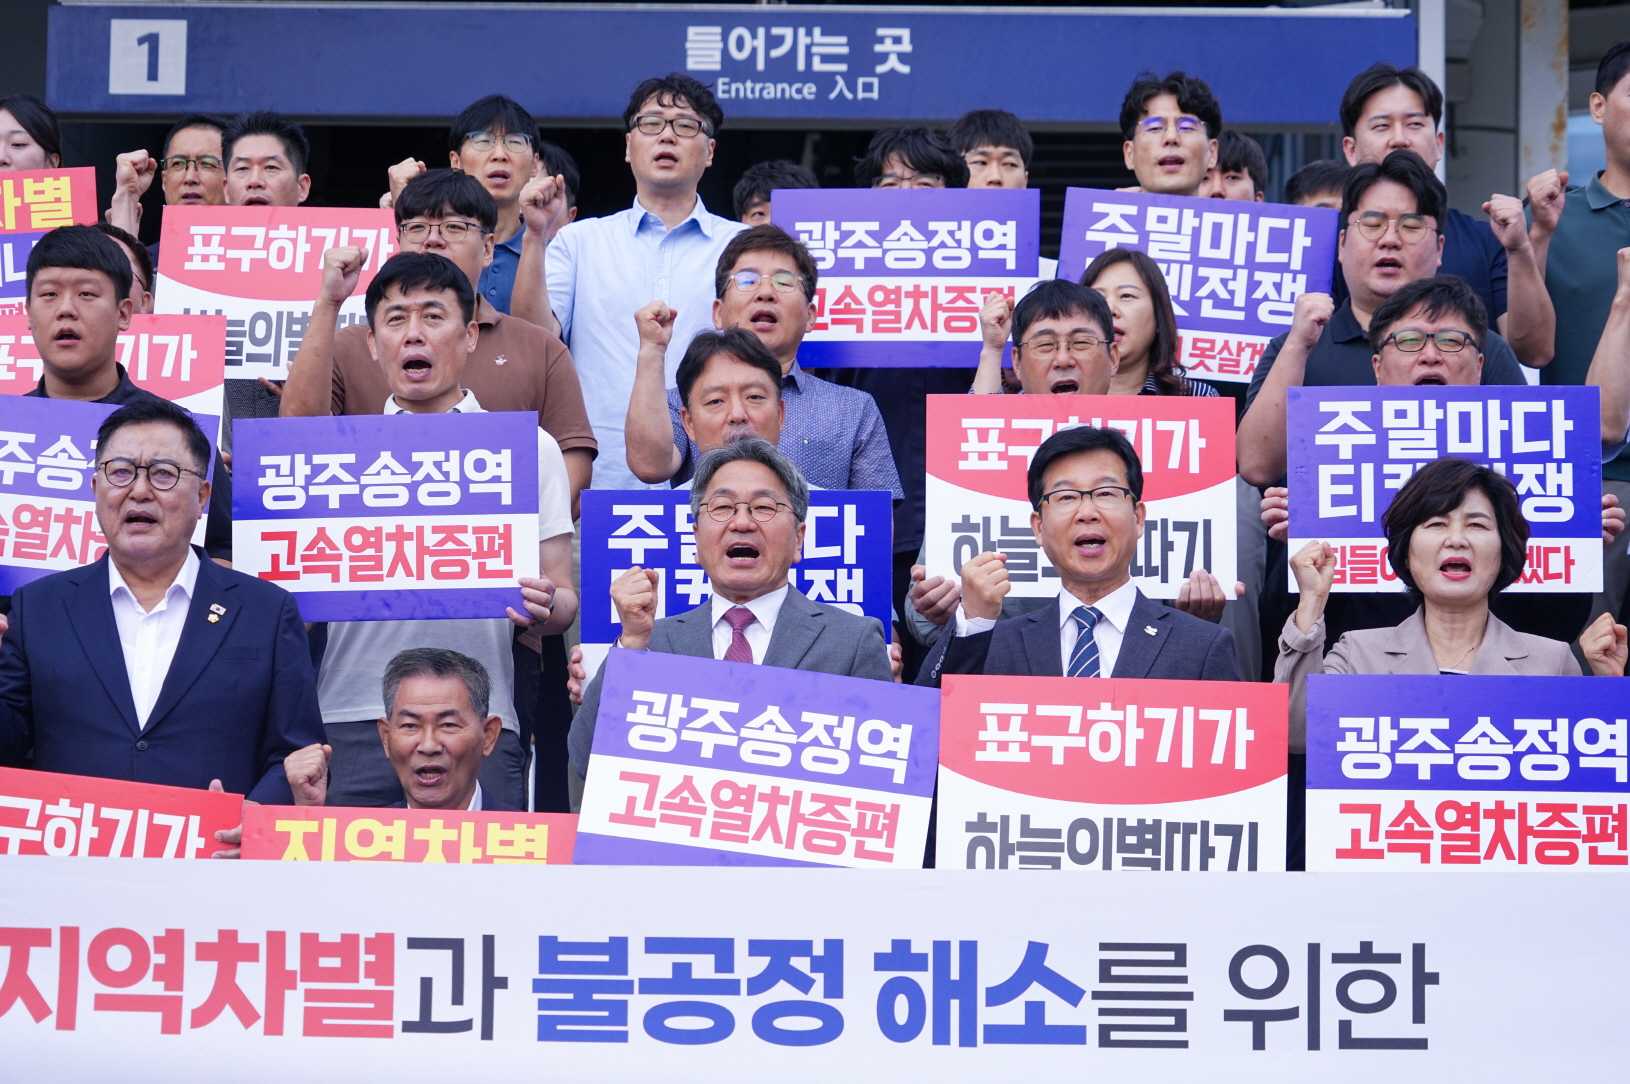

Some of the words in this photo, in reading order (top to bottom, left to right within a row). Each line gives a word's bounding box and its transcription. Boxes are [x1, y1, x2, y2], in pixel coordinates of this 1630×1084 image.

[136, 31, 160, 82] 1
[685, 25, 850, 72] 들어가는
[874, 27, 913, 75] 곳
[717, 76, 817, 100] Entrance
[794, 220, 1017, 270] 광주송정역
[1085, 202, 1312, 270] 주말마다
[1315, 399, 1574, 459] 주말마다
[257, 449, 512, 510] 광주송정역
[258, 524, 514, 583] 고속열차증편
[626, 690, 913, 785] 광주송정역
[975, 702, 1255, 770] 표구하기가
[1336, 716, 1628, 783] 광주송정역
[608, 771, 901, 864] 고속열차증편
[1335, 799, 1629, 866] 고속열차증편
[0, 926, 509, 1041] 지역차별과
[532, 935, 844, 1047] 불공정
[873, 939, 1195, 1049] 해소를
[1223, 941, 1441, 1052] 위한
